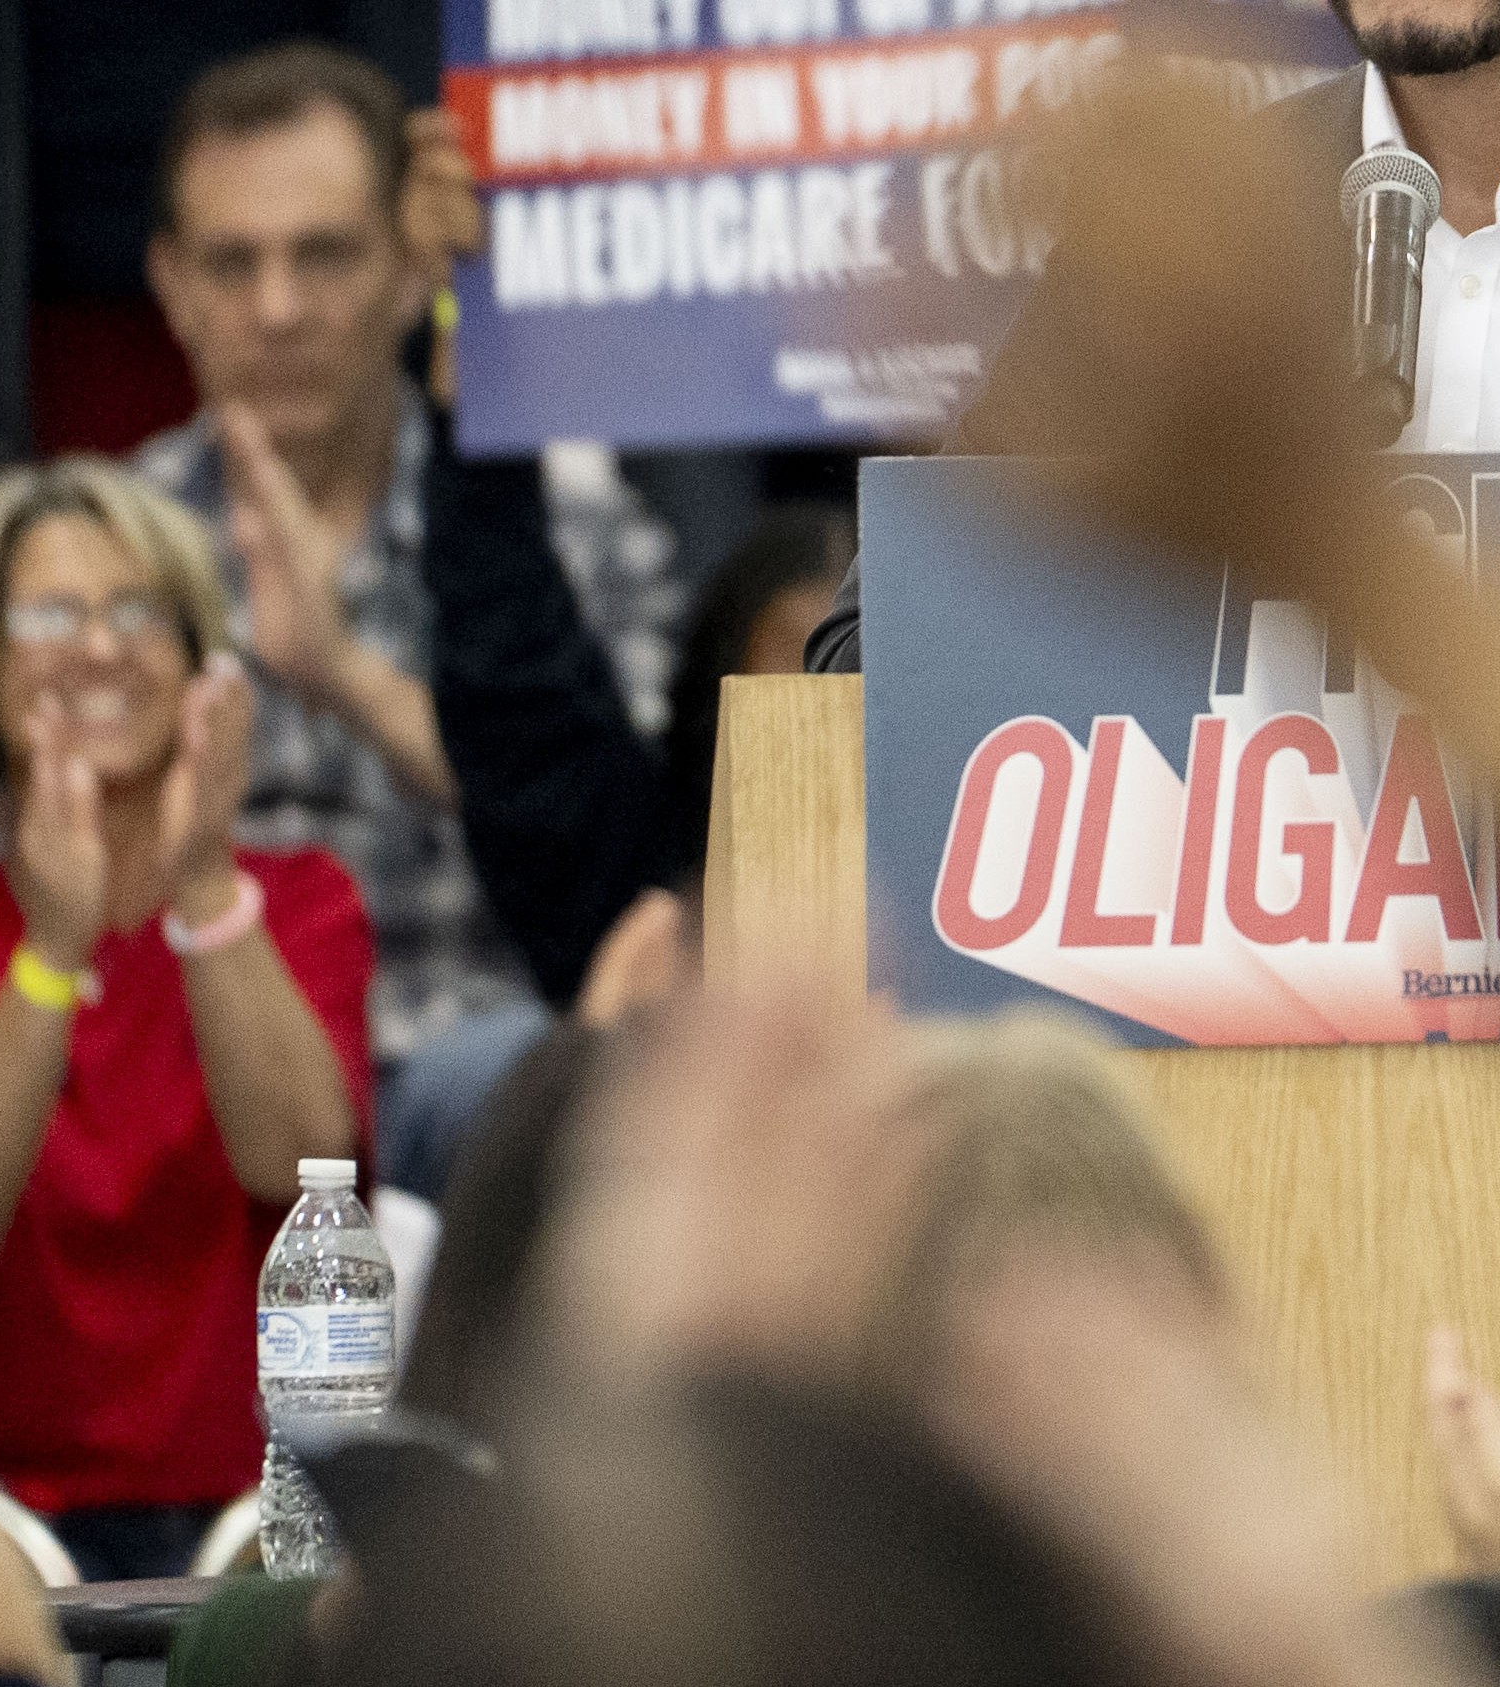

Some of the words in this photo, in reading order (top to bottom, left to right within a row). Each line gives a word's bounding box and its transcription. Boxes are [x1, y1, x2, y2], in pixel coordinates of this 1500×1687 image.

[488, 67, 710, 170] MONEY
[722, 59, 802, 157] IN
[810, 45, 981, 147] YOUR
[490, 158, 900, 312] MEDICARE
